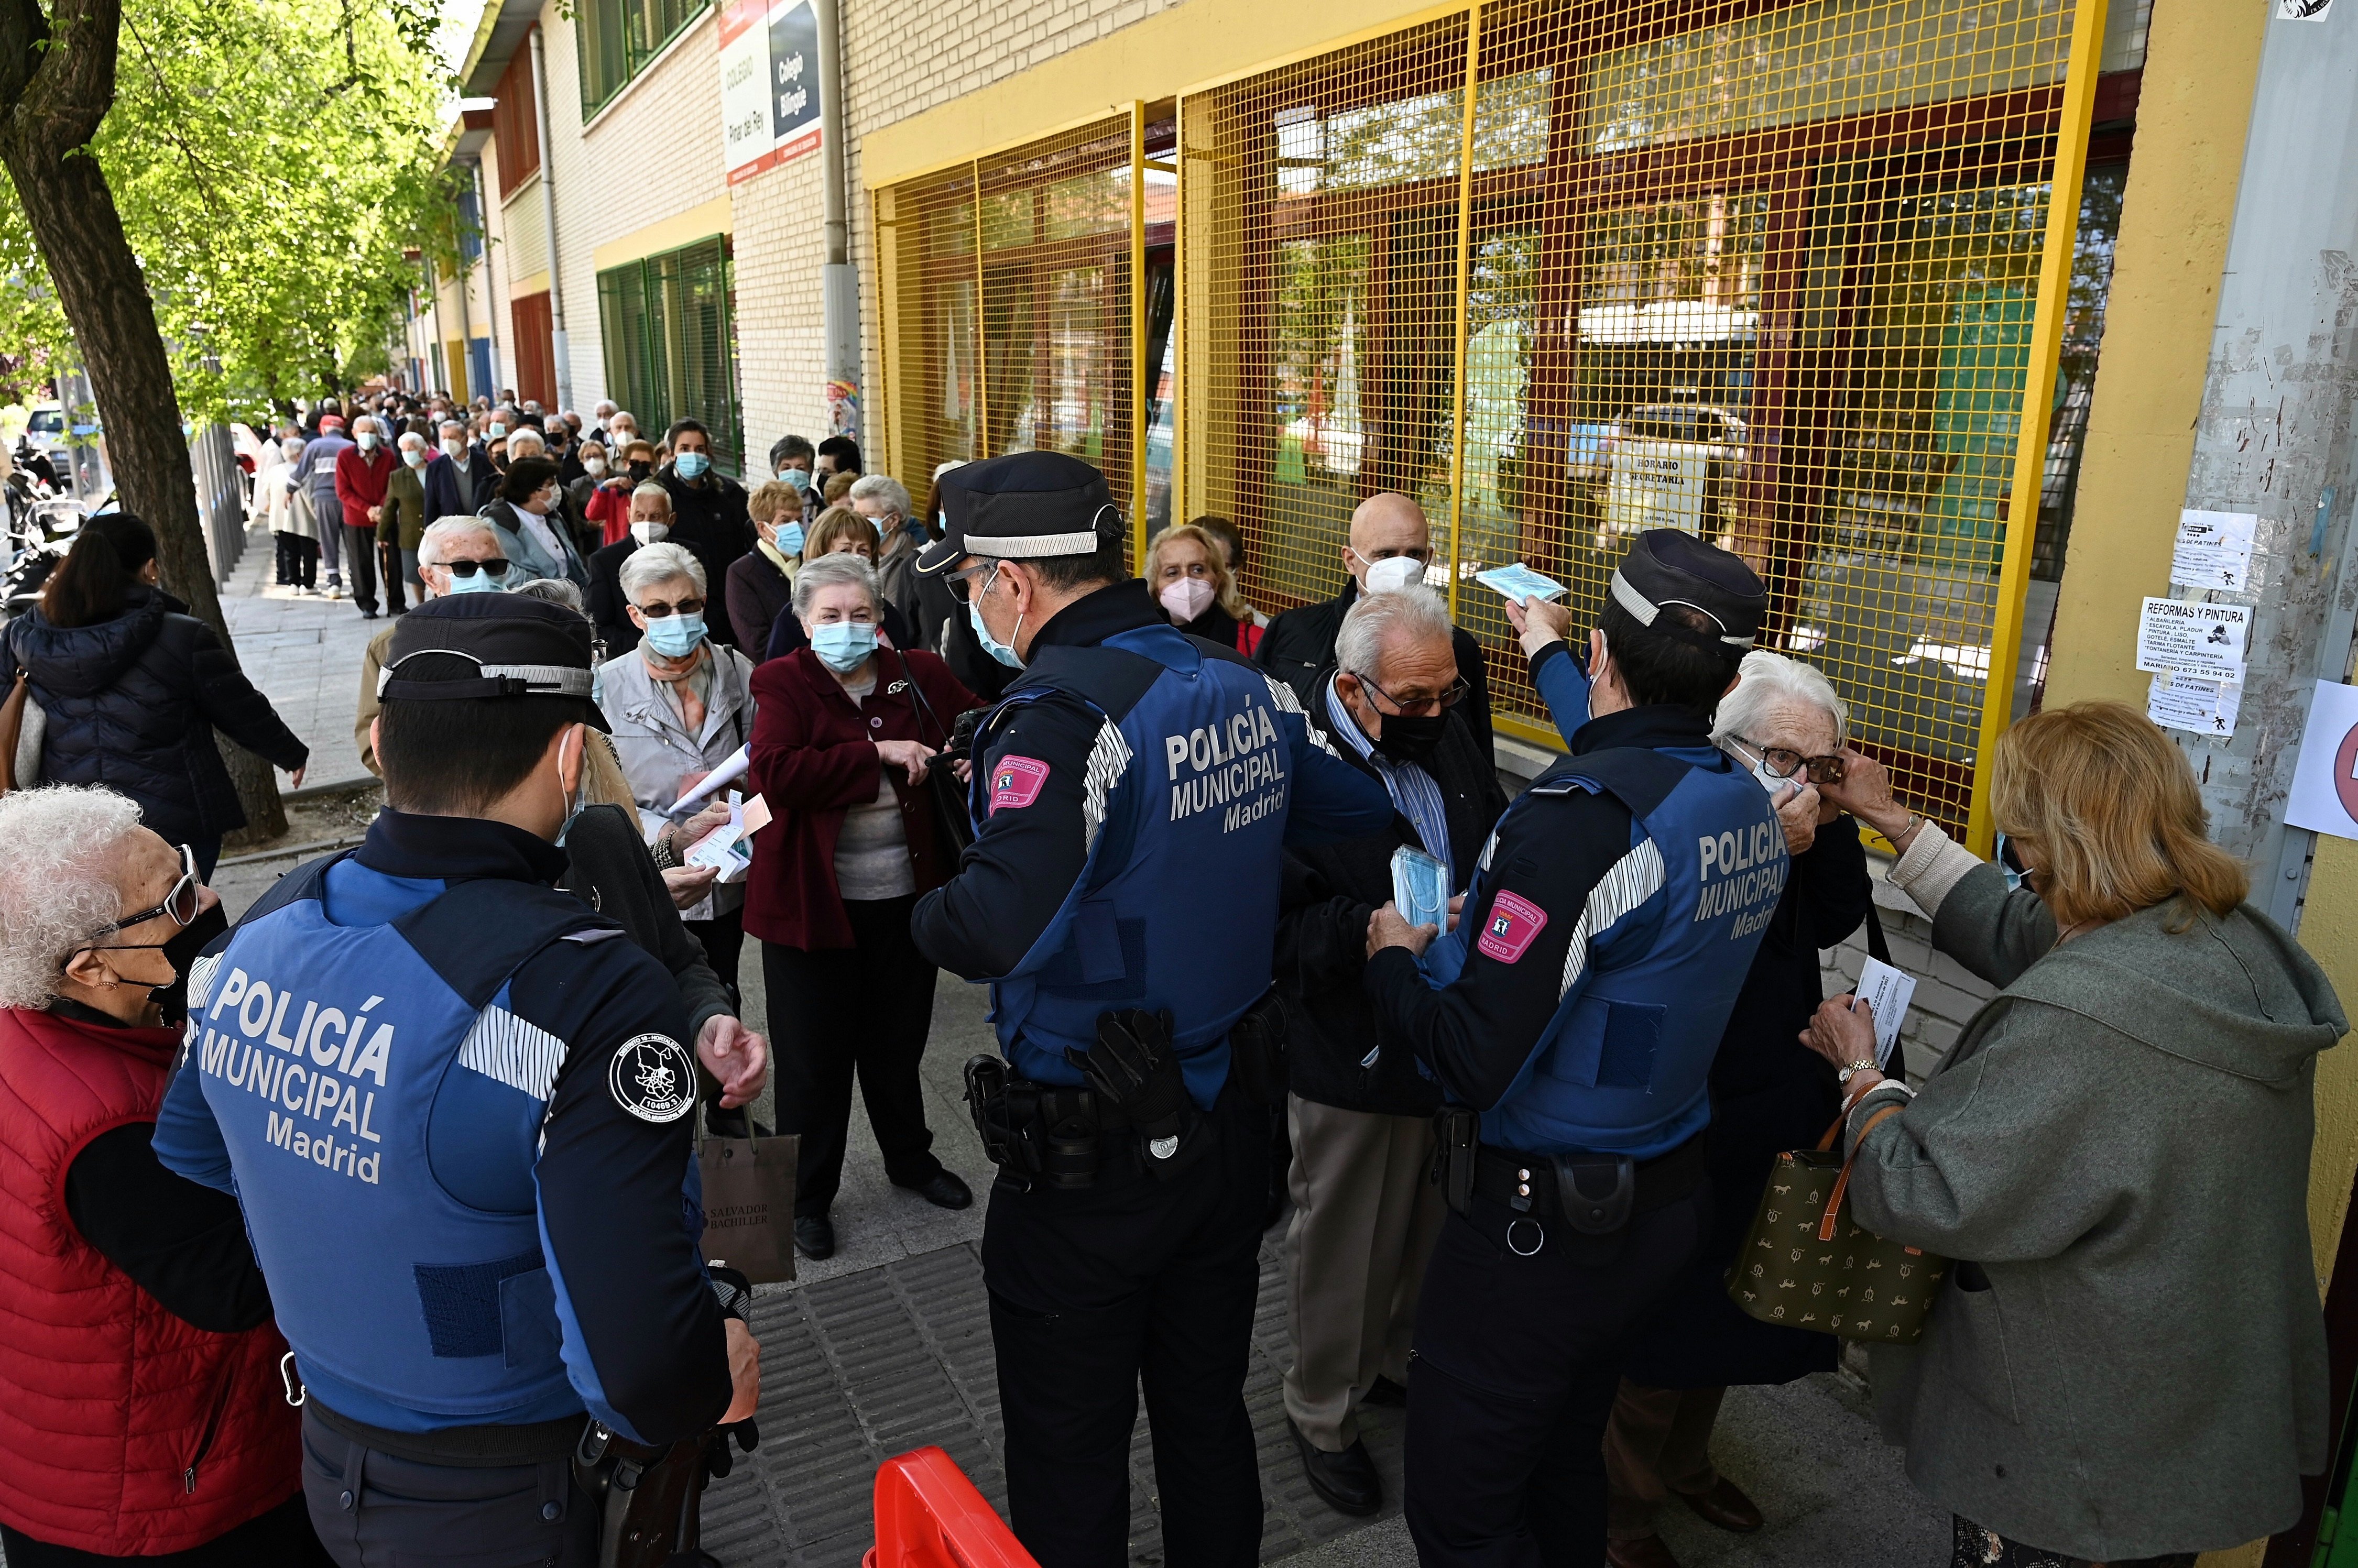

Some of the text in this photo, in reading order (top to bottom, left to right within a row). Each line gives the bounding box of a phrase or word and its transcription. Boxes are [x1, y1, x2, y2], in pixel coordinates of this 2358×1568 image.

[726, 56, 753, 91] COLEGIO
[779, 51, 803, 84] Colegio
[729, 125, 742, 146] Pinar
[753, 111, 763, 135] Rey
[1638, 459, 1678, 470] HORARIO
[1629, 473, 1685, 485] SECRETARÍA
[2147, 602, 2243, 623] REFORMAS Y PINTURA
[2144, 661, 2180, 671] MARIANO
[2185, 651, 2223, 660] CARPINTERÍA
[2185, 684, 2214, 693] PATINES
[1165, 694, 1278, 781] POLICÍA
[1002, 761, 1040, 773] MUNICIPAL
[1171, 748, 1284, 821] MUNICIPAL
[1224, 784, 1284, 834] Madrid
[1699, 804, 1787, 882] POLICÍA
[1694, 862, 1784, 922] MUNICIPAL
[1506, 900, 1536, 923] MUNICIPAL
[1481, 937, 1508, 954] MADRID
[1875, 980, 1884, 1000] Asamblea
[210, 968, 395, 1087] POLICÍA
[619, 1038, 641, 1057] DISTRITO
[651, 1035, 680, 1052] HORTALEZA
[202, 1028, 380, 1143] MUNICIPAL
[629, 1097, 692, 1121] POLICÍA MUNICIPAL MADRID
[647, 1099, 678, 1110] 10469.3
[266, 1110, 380, 1185] Madrid
[710, 1204, 768, 1218] SALVADOR
[710, 1214, 767, 1229] BACHILLER
